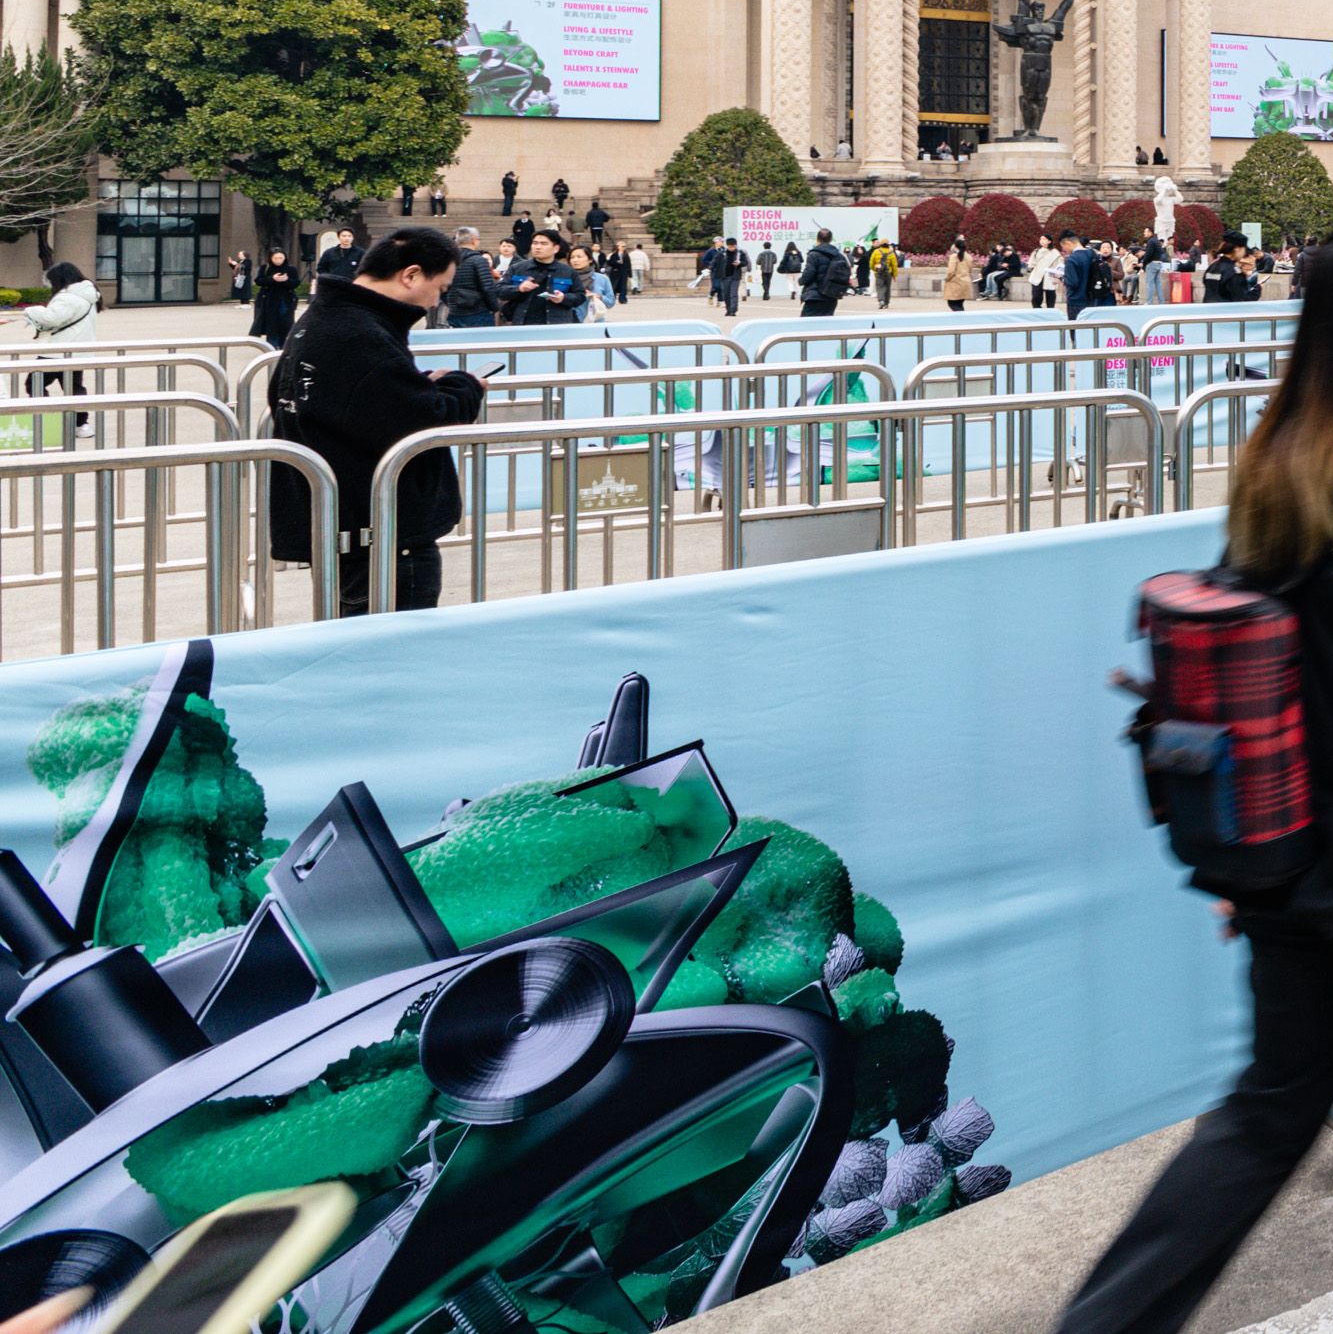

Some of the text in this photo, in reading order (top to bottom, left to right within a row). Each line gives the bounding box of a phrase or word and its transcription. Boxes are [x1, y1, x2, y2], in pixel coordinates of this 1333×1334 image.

[563, 2, 648, 14] FURNITURE & LIGHTING
[563, 26, 588, 34] LIVING
[599, 27, 633, 36] LIFESTYLE
[563, 49, 618, 58] BEYOND CRAFT
[563, 64, 593, 72] TALENTS
[602, 66, 639, 74] STEINWAY
[563, 80, 611, 89] CHAMPAGNE
[742, 209, 782, 219] DESIGN
[742, 221, 799, 231] SHANGHAI
[742, 231, 773, 242] 2026
[1151, 356, 1175, 366] VENT
